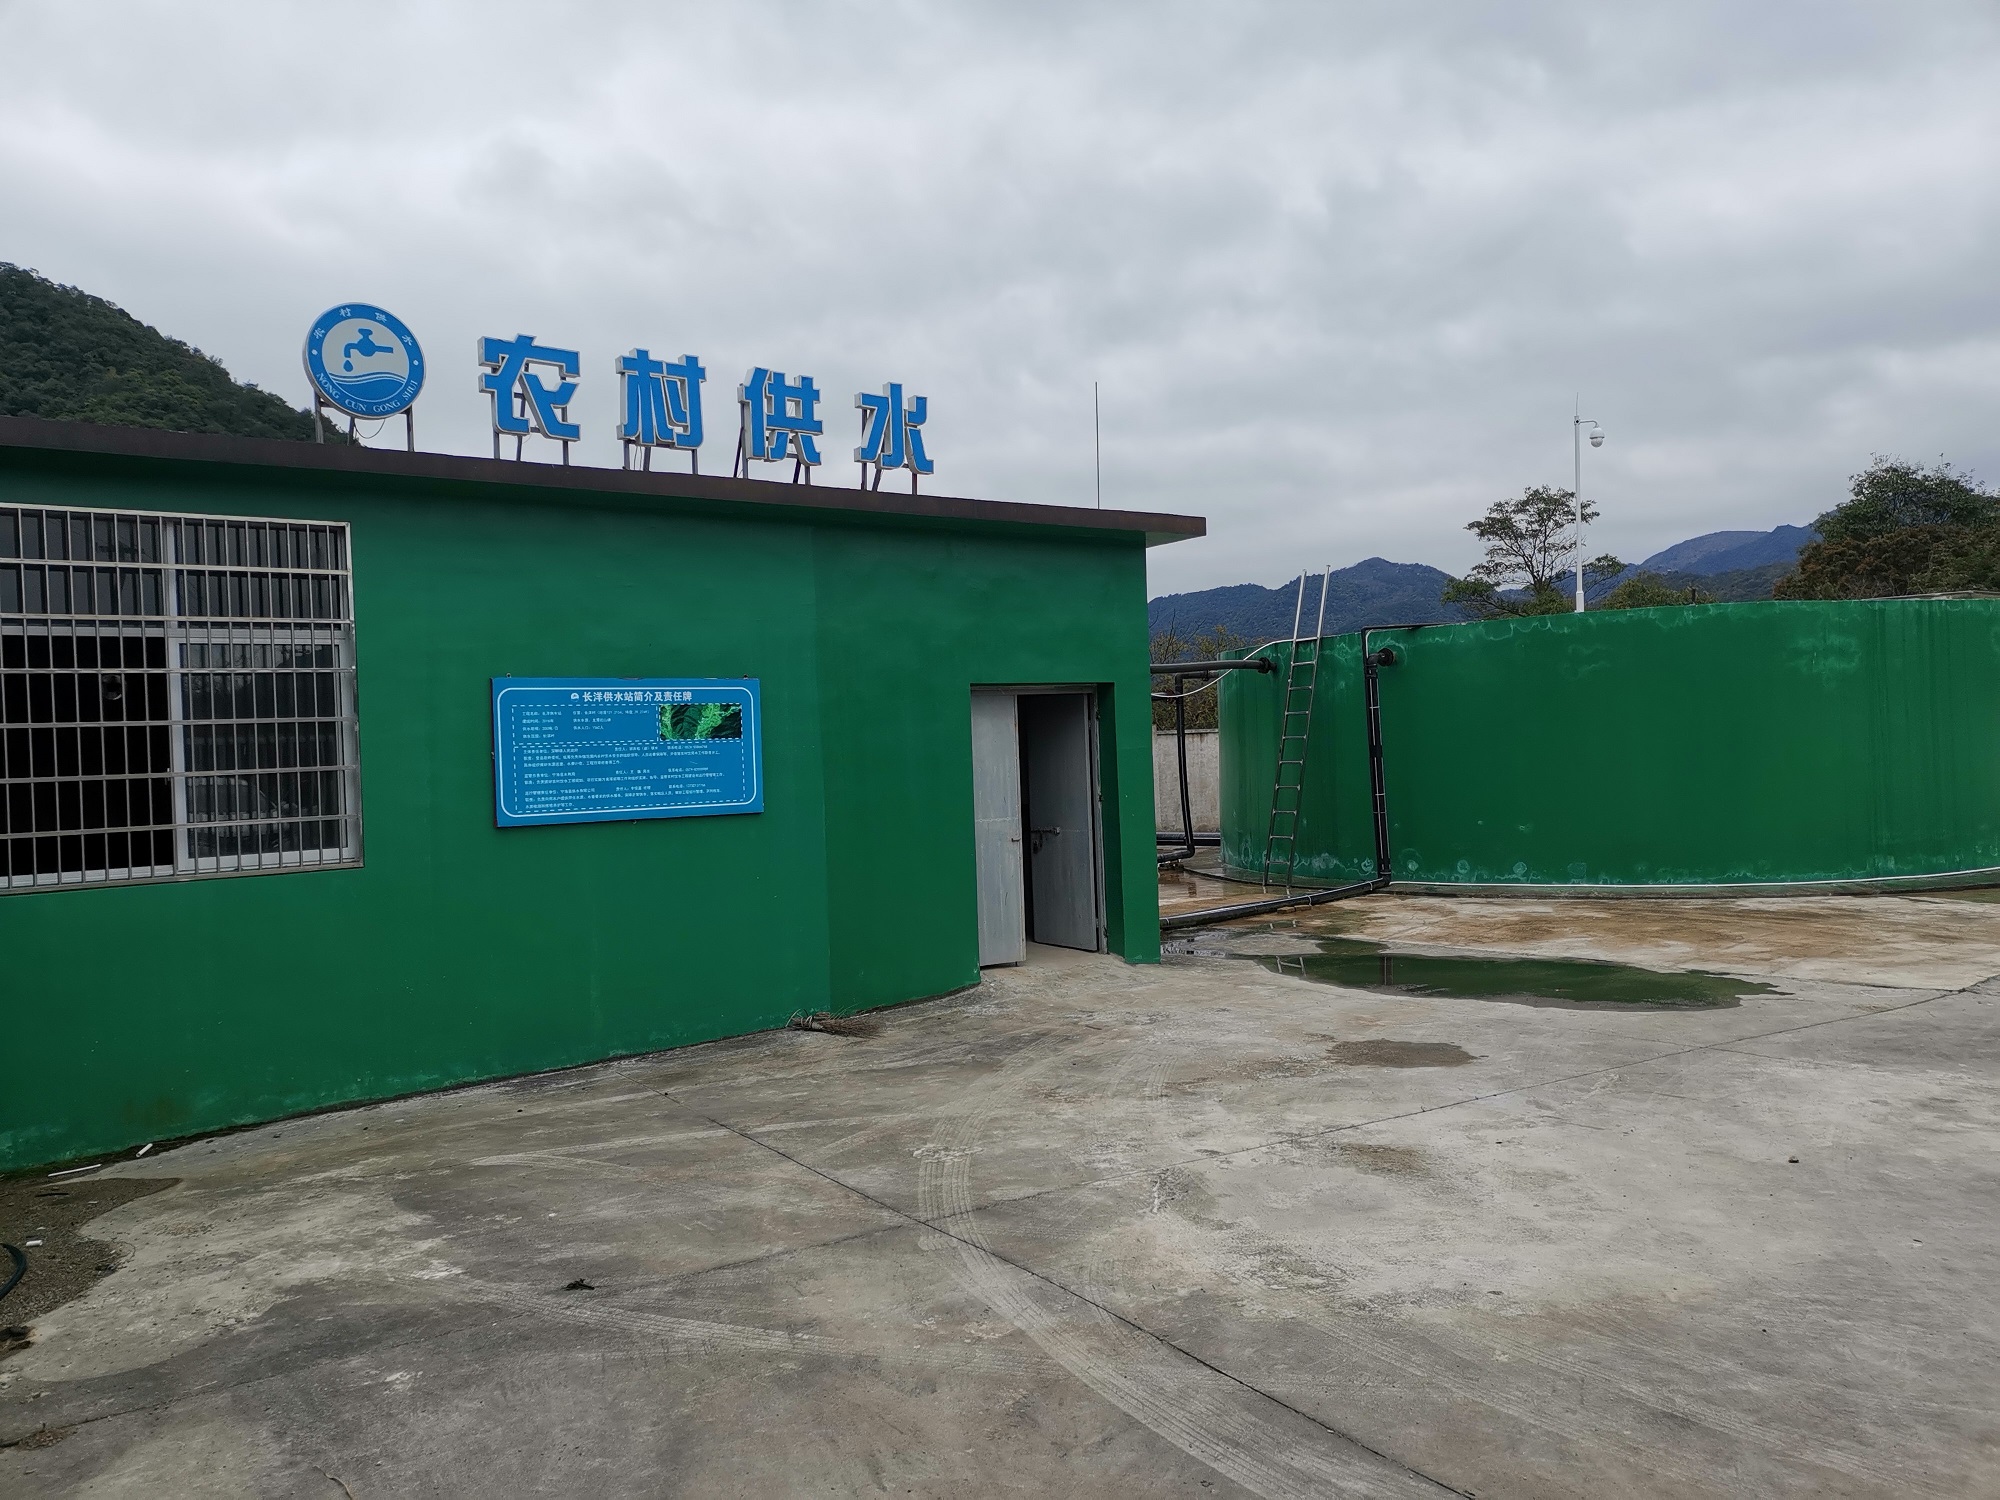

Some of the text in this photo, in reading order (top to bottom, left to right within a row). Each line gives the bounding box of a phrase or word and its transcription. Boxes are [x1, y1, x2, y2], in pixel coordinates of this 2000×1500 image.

[313, 307, 413, 346] 农村供水
[317, 373, 418, 412] NONG CUN GONG SHUI
[478, 333, 934, 475] 农村供水
[582, 691, 692, 702] 长洋供水站简介及责任牌
